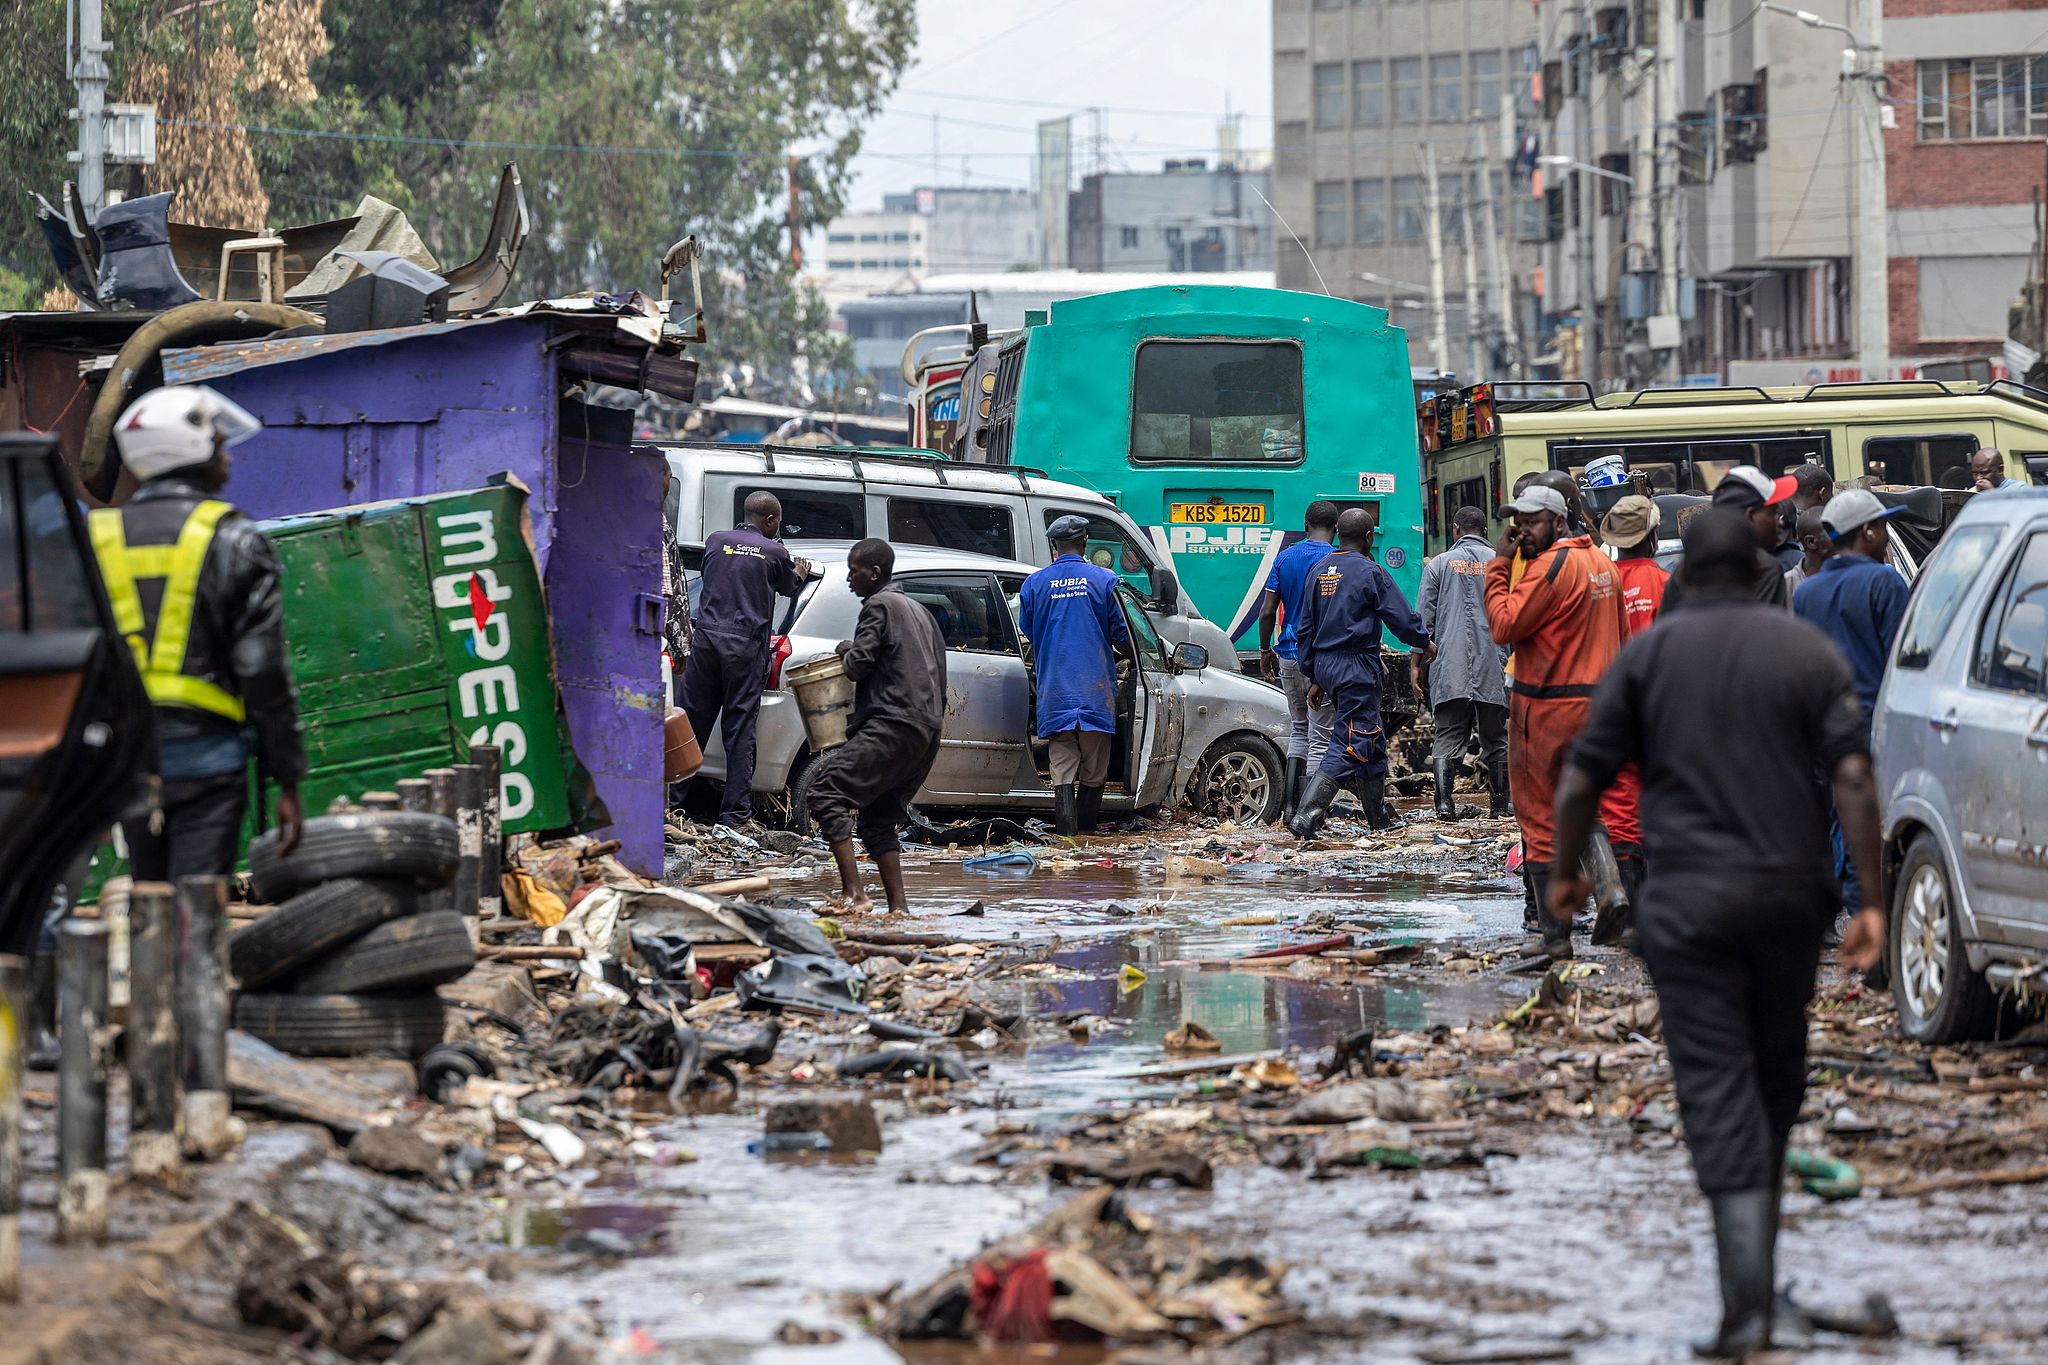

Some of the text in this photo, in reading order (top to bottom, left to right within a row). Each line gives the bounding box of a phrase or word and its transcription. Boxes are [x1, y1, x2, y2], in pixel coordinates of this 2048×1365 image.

[1361, 477, 1376, 487] 80
[1185, 505, 1261, 523] KBS 152D
[1388, 550, 1403, 561] 80
[1050, 577, 1088, 588] RUBIA
